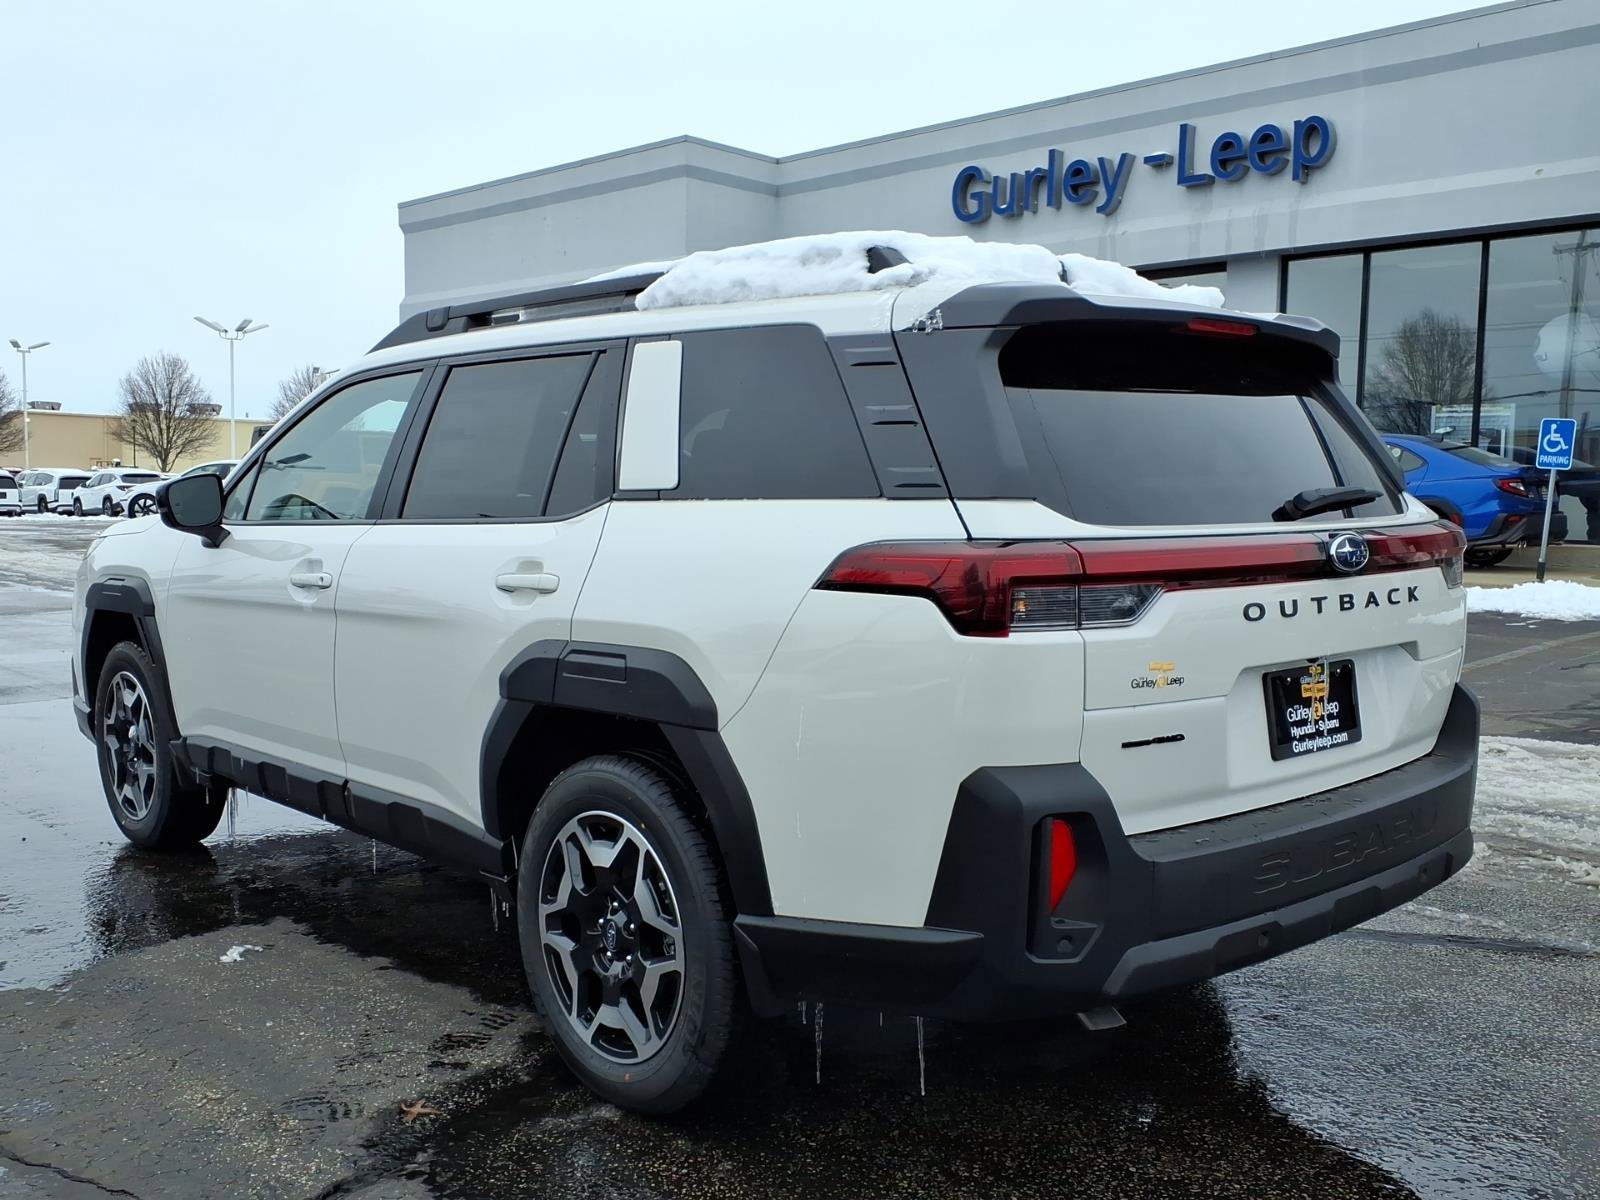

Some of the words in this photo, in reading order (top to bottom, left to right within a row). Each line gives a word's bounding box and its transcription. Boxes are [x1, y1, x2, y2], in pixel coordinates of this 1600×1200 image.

[1540, 455, 1569, 465] PARKING
[1243, 586, 1420, 622] OUTBACK
[1131, 677, 1157, 689] Gurley
[1166, 676, 1185, 687] Leep
[1287, 706, 1312, 722] Gurley
[1293, 732, 1348, 752] Gurleyleep.com
[1253, 805, 1438, 894] SUBARU
